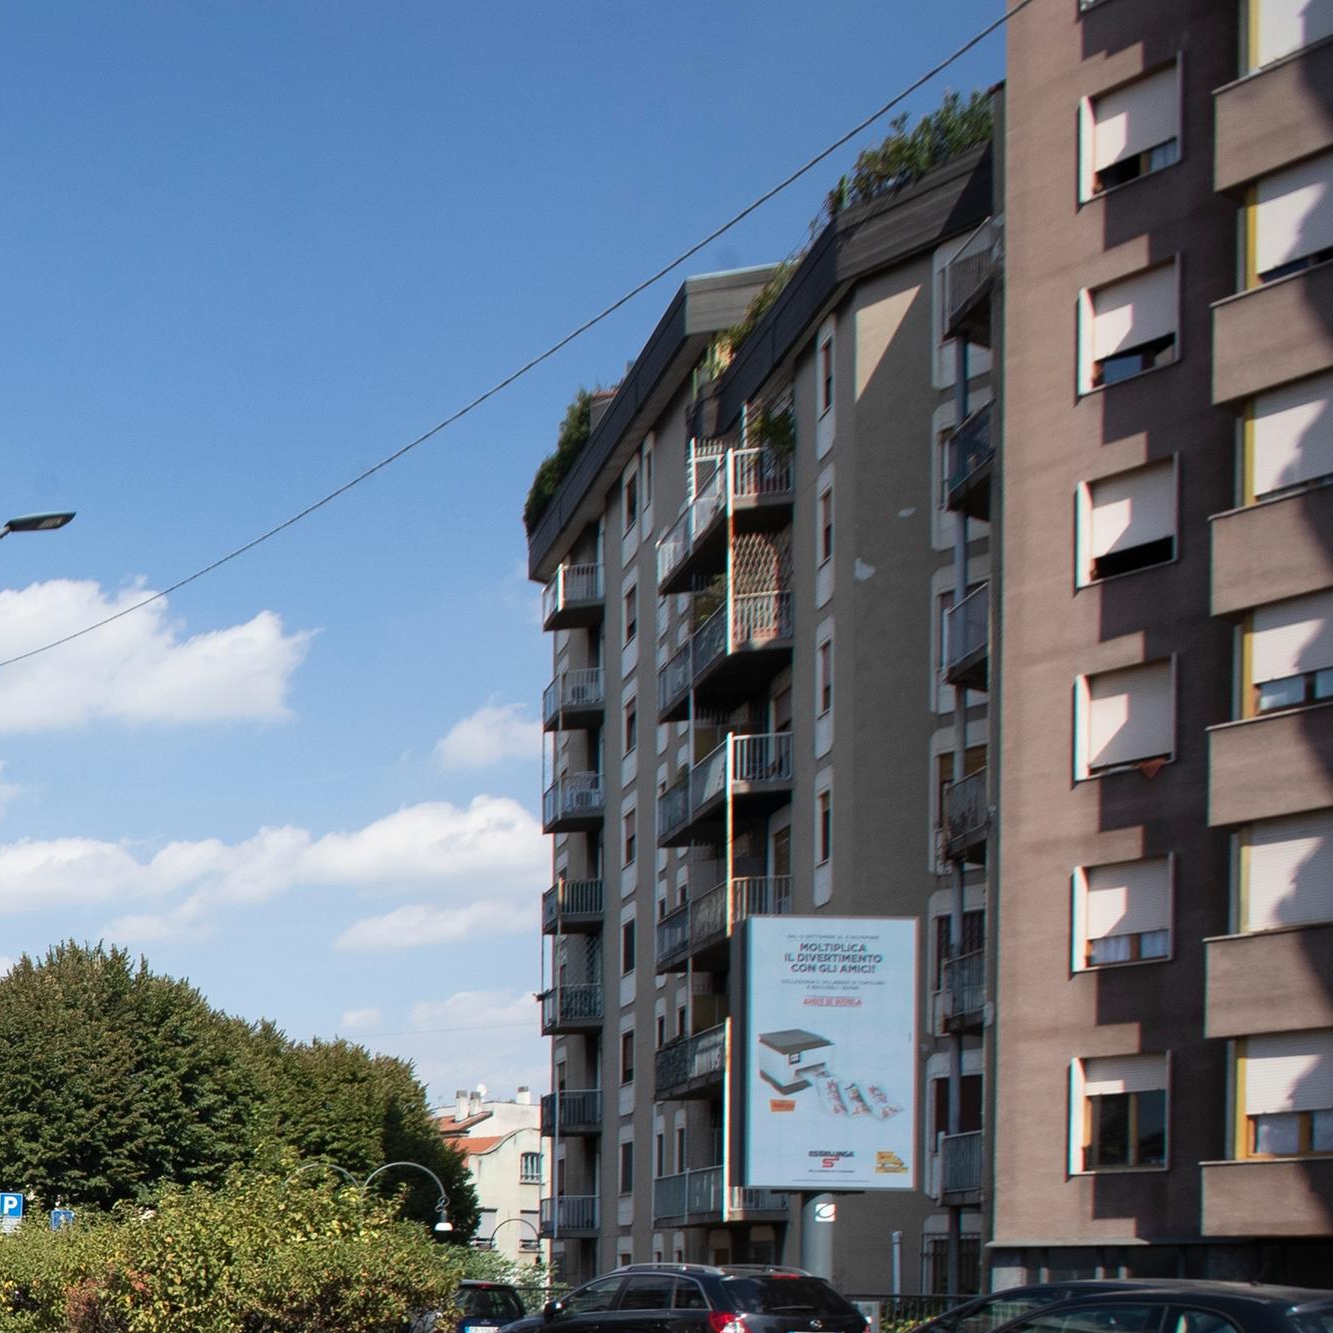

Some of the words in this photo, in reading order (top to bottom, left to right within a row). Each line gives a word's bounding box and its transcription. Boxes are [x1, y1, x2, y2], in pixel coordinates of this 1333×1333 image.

[799, 943, 867, 952] MOLTIPLICA
[784, 953, 795, 962] IL
[797, 953, 883, 963] DIVERTIMENTO
[791, 964, 816, 973] CON
[819, 964, 837, 973] GLI
[3, 1196, 18, 1214] P
